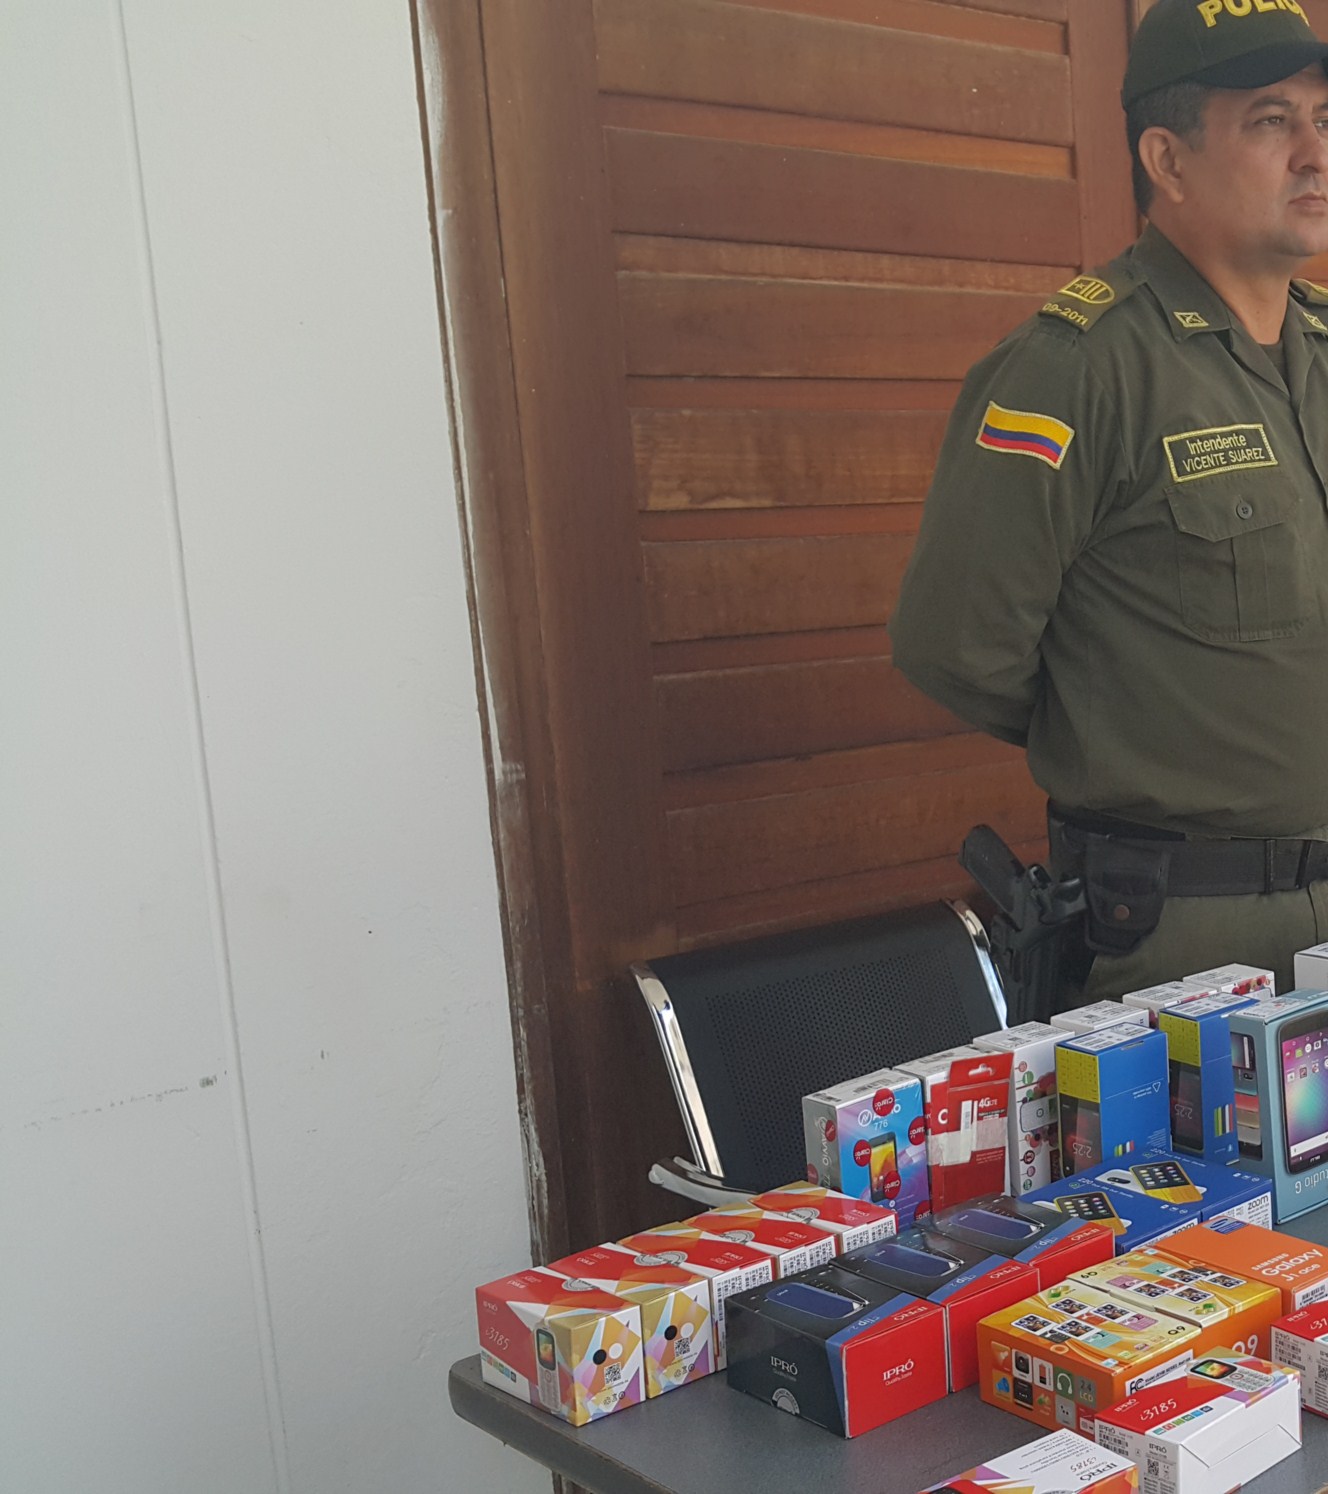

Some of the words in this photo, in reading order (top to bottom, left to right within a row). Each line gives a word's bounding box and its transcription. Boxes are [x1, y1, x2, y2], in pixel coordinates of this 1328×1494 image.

[1042, 303, 1088, 326] 09-2011
[1186, 433, 1247, 455] Intendente
[1183, 452, 1227, 472] VICENTE
[1228, 447, 1266, 463] SUAREZ
[1294, 1180, 1303, 1195] G
[1251, 1253, 1290, 1271] SAMSUNG
[1262, 1249, 1323, 1276] Galaxy
[1299, 1263, 1321, 1275] ace
[770, 1356, 798, 1376] IPRÓ
[883, 1358, 914, 1381] IPRÓ
